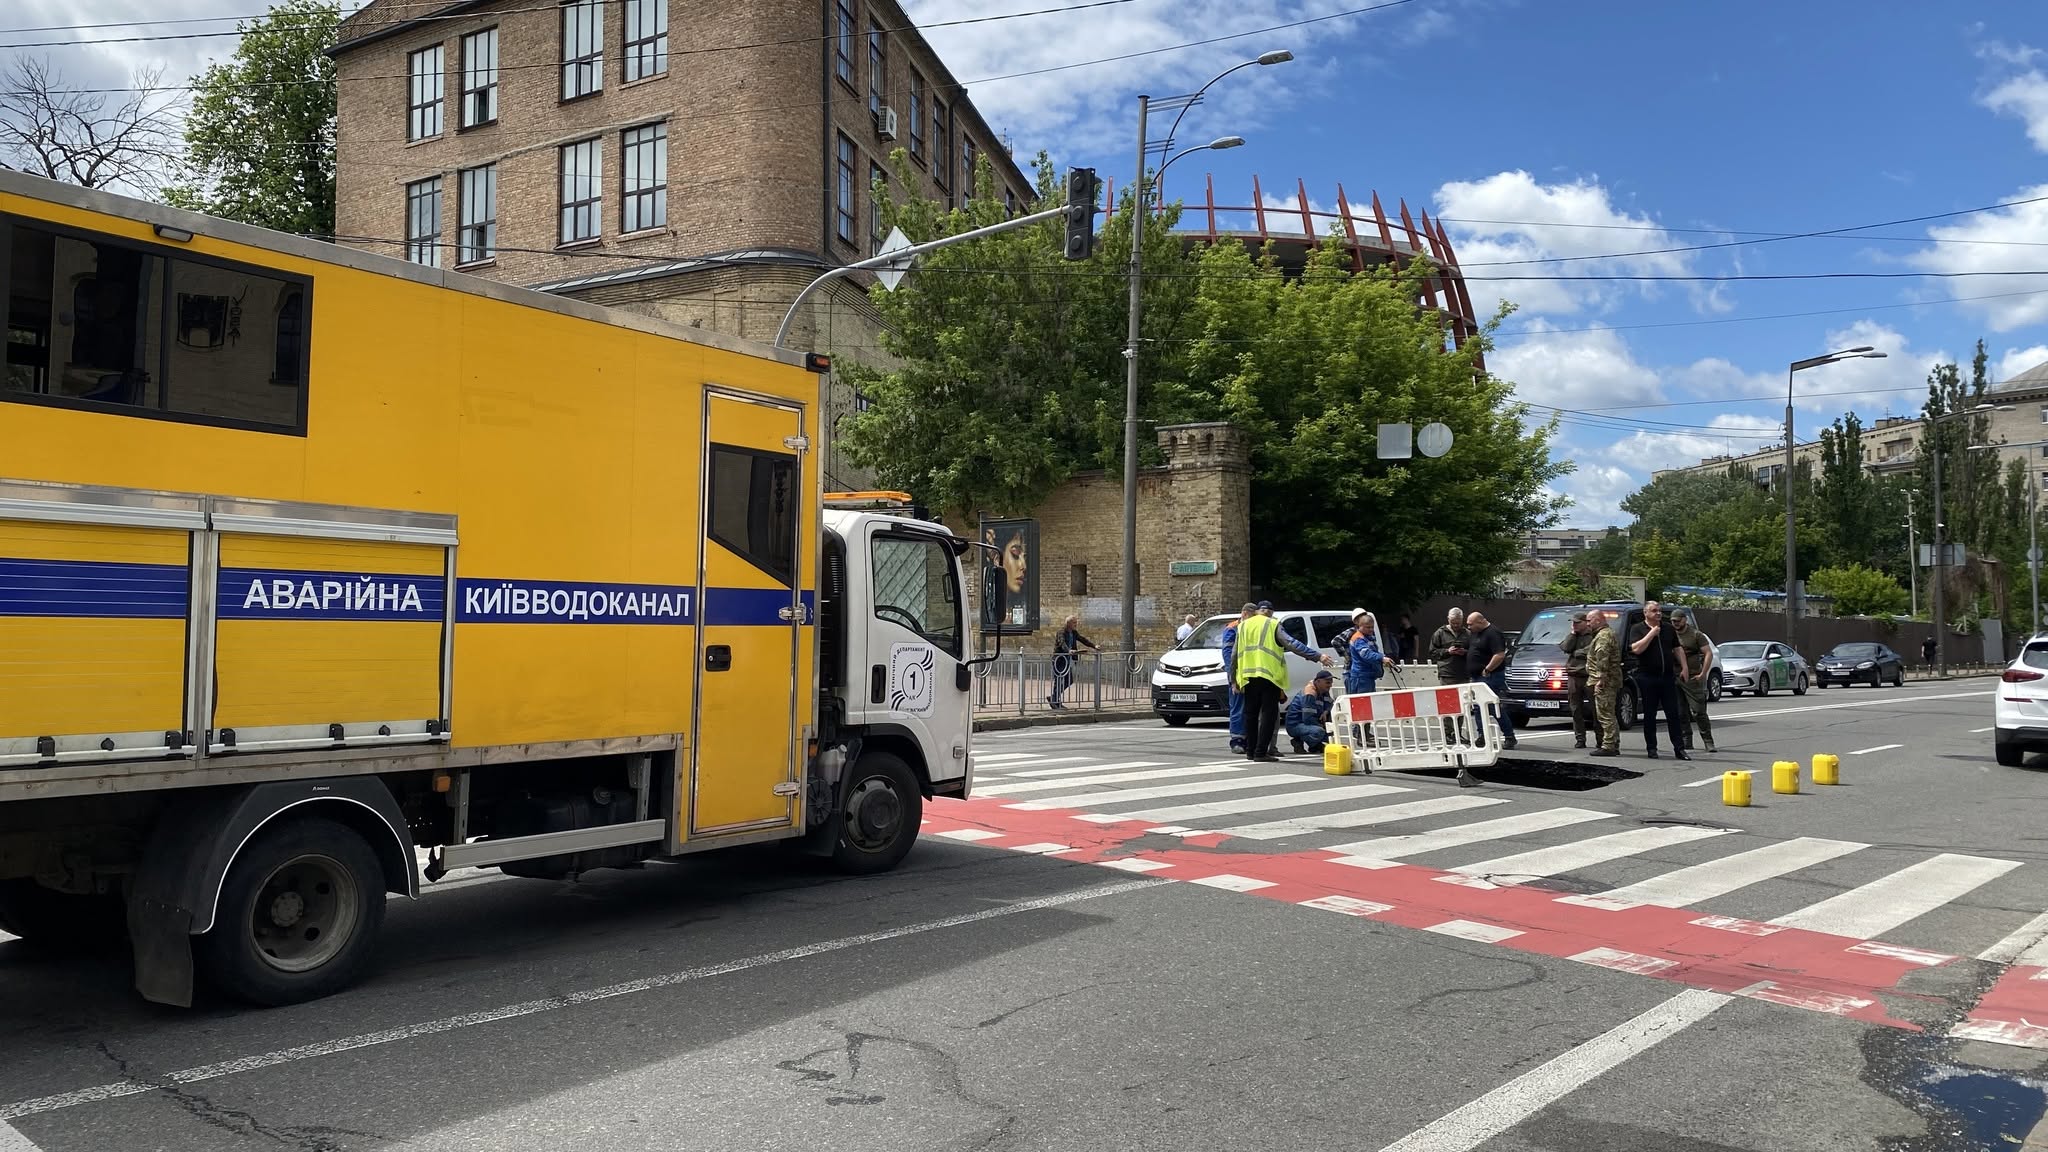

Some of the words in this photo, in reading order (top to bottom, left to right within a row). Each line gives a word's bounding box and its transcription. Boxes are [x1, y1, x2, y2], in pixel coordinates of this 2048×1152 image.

[243, 575, 424, 612] АВАРІЙНА
[464, 583, 690, 620] КИЇВВОДОКАНАЛ
[909, 671, 916, 690] 1
